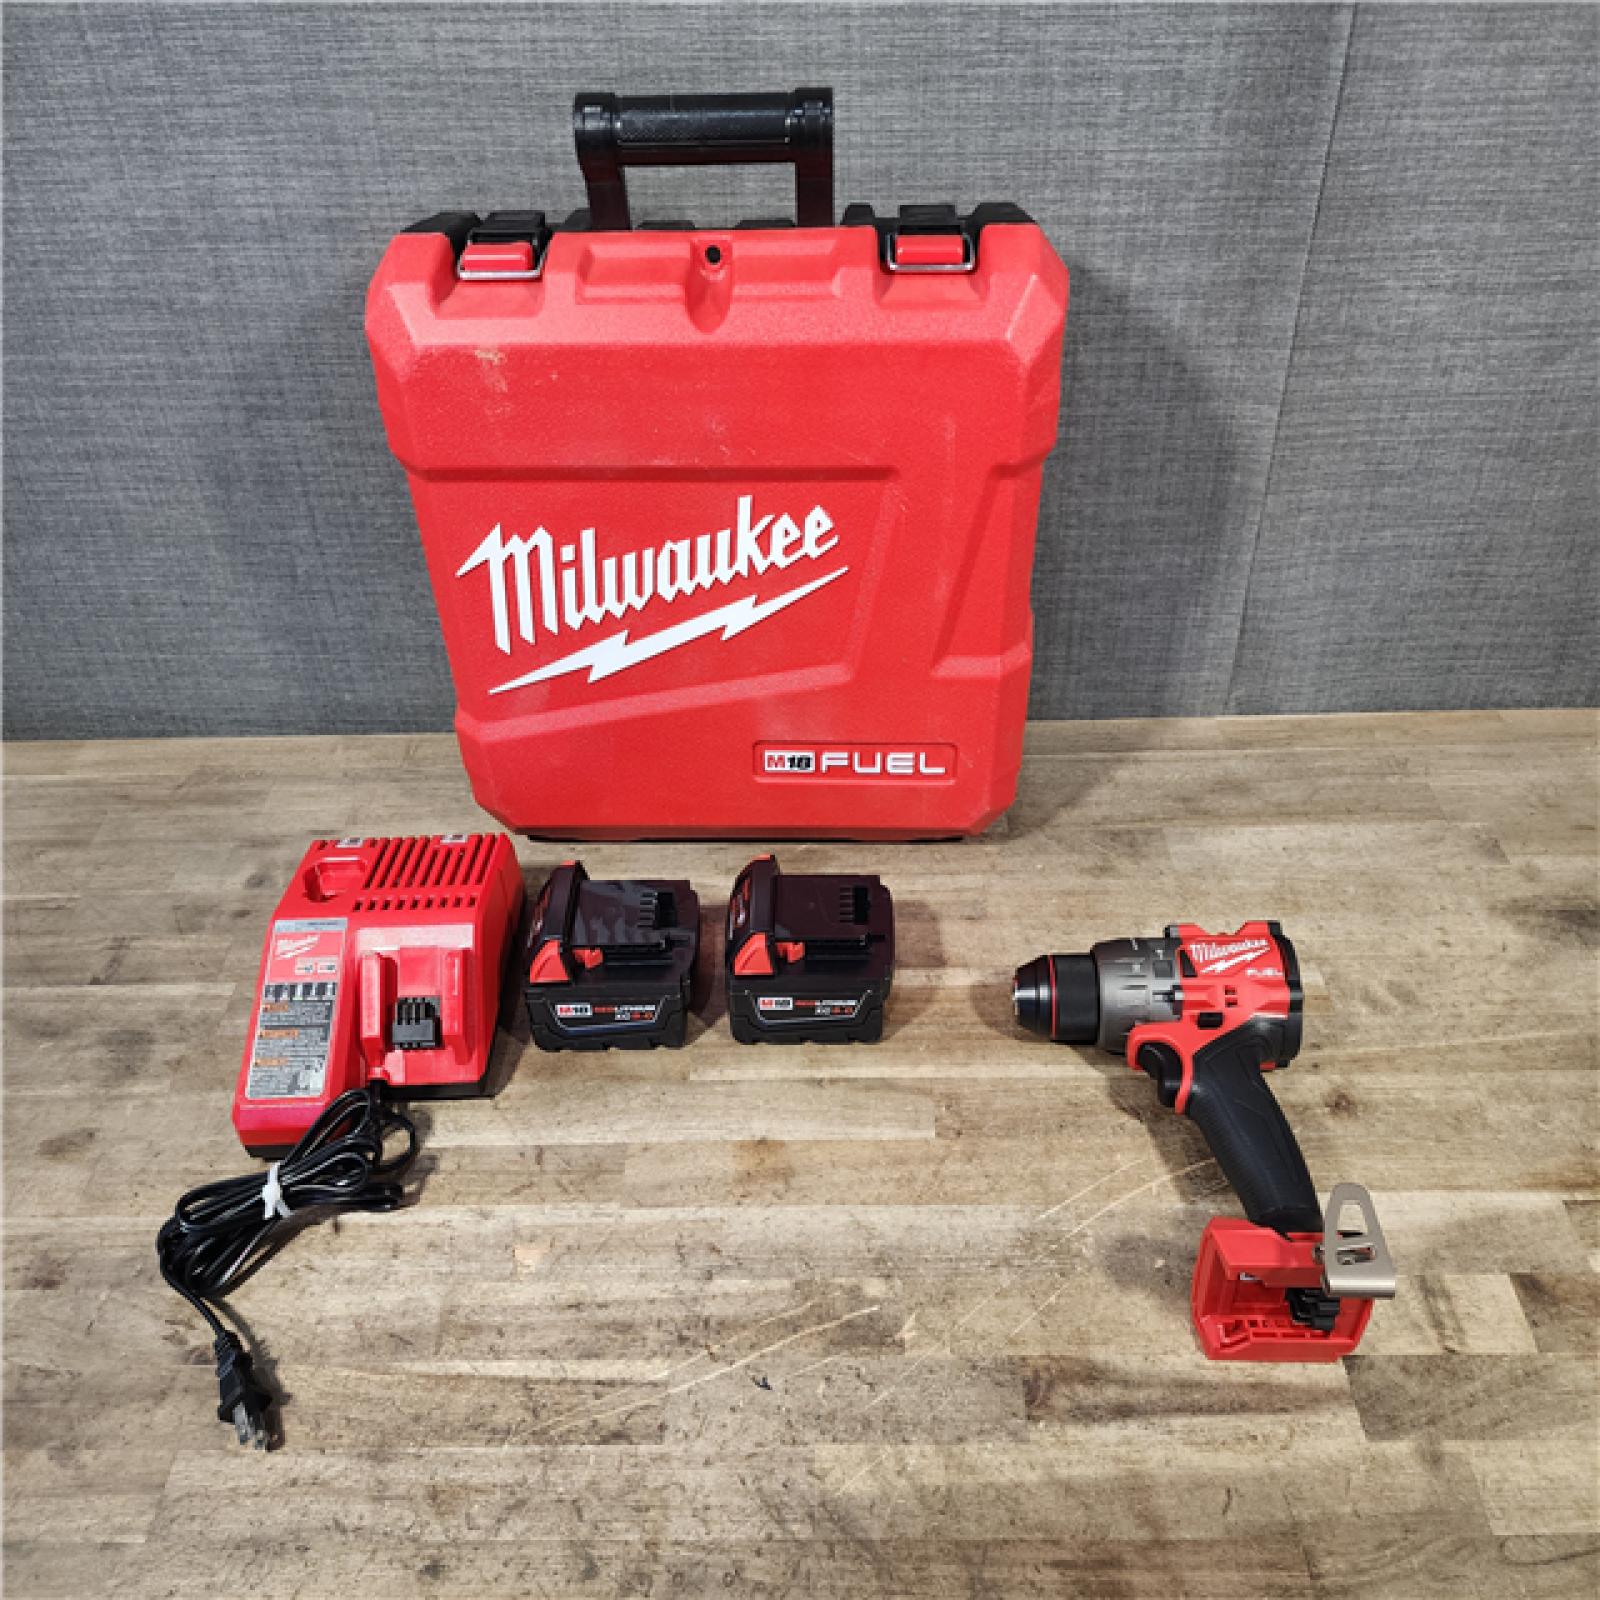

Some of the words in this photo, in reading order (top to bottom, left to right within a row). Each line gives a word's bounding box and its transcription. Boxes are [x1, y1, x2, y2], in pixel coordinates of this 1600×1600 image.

[455, 494, 840, 656] Milwaukee
[766, 753, 814, 770] M18
[821, 751, 946, 774] FUEL
[1189, 937, 1269, 963] Milwaukee
[1247, 967, 1283, 977] FUEL
